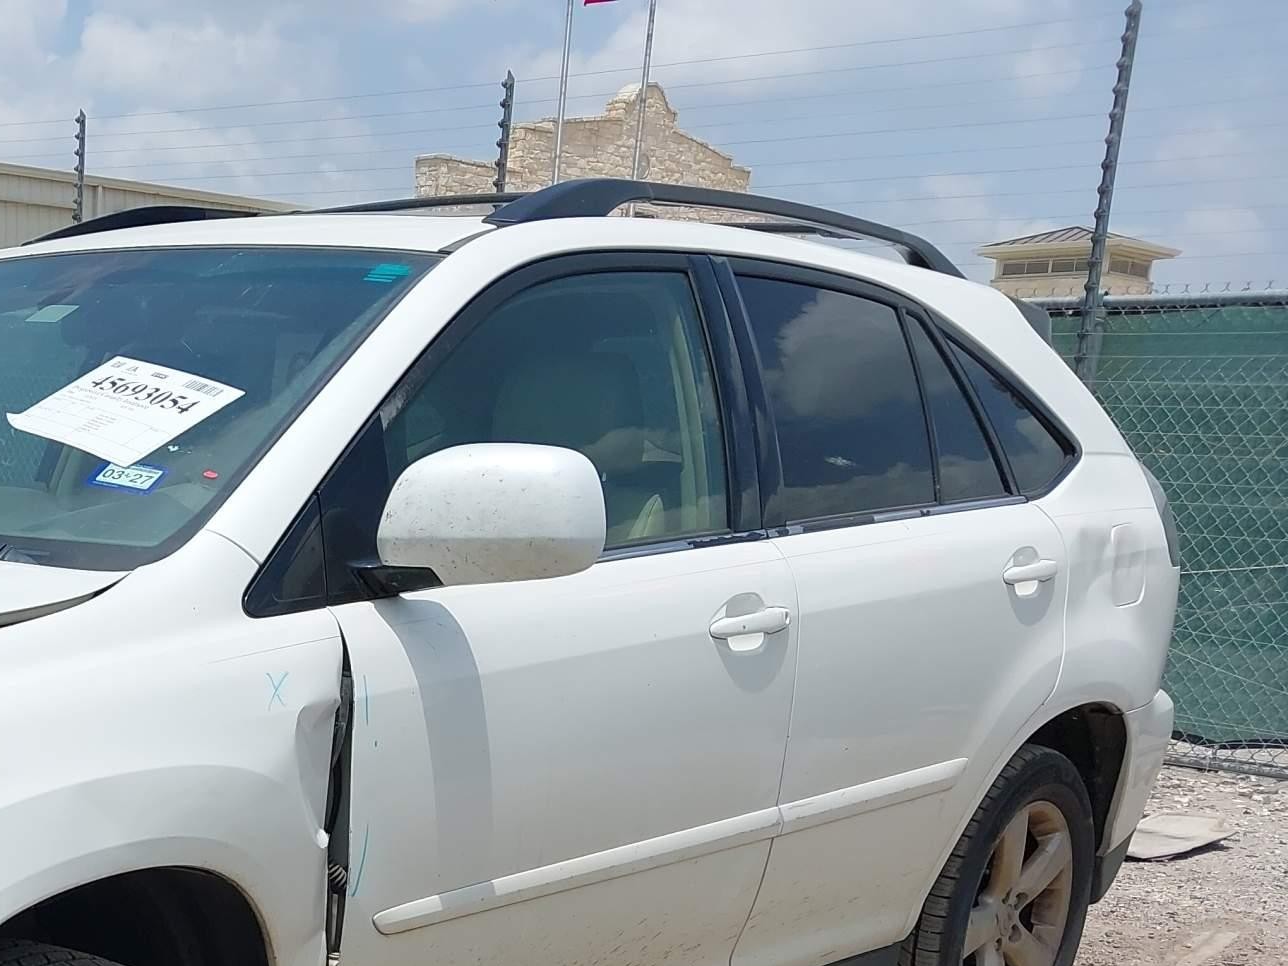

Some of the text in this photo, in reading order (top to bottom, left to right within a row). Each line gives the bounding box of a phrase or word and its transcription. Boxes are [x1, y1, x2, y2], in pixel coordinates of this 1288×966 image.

[91, 375, 200, 414] 45693054
[102, 468, 125, 480] 03
[128, 473, 155, 485] 27
